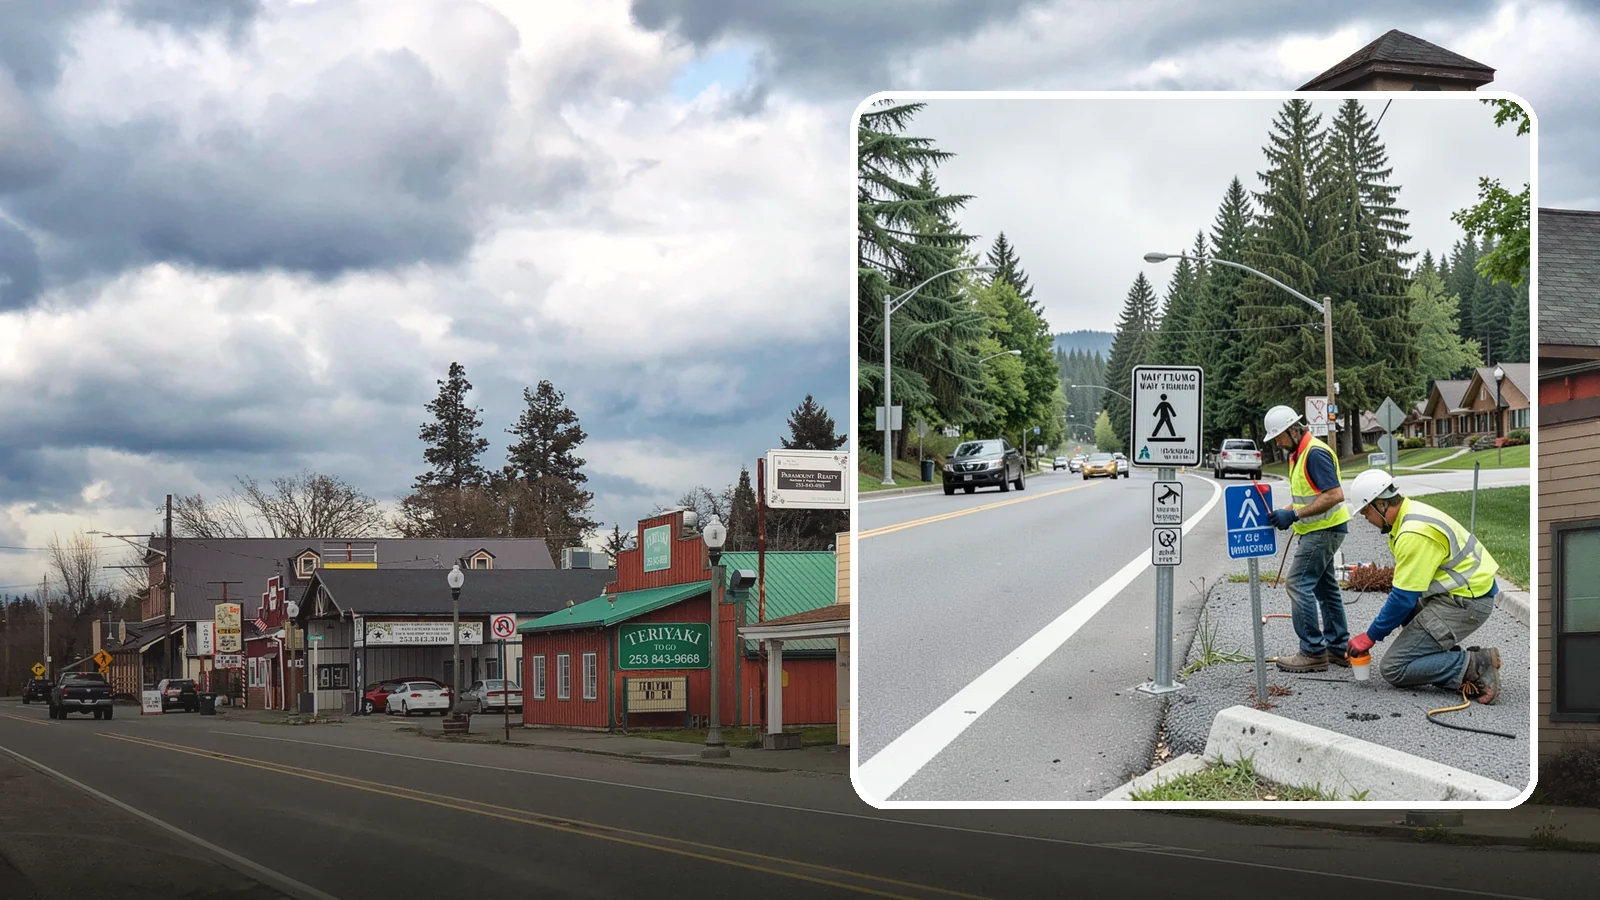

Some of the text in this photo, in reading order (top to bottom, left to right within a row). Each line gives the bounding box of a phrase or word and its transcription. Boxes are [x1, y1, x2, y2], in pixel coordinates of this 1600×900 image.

[625, 627, 702, 646] TERIYAKI
[629, 653, 700, 664] 253 843-9668
